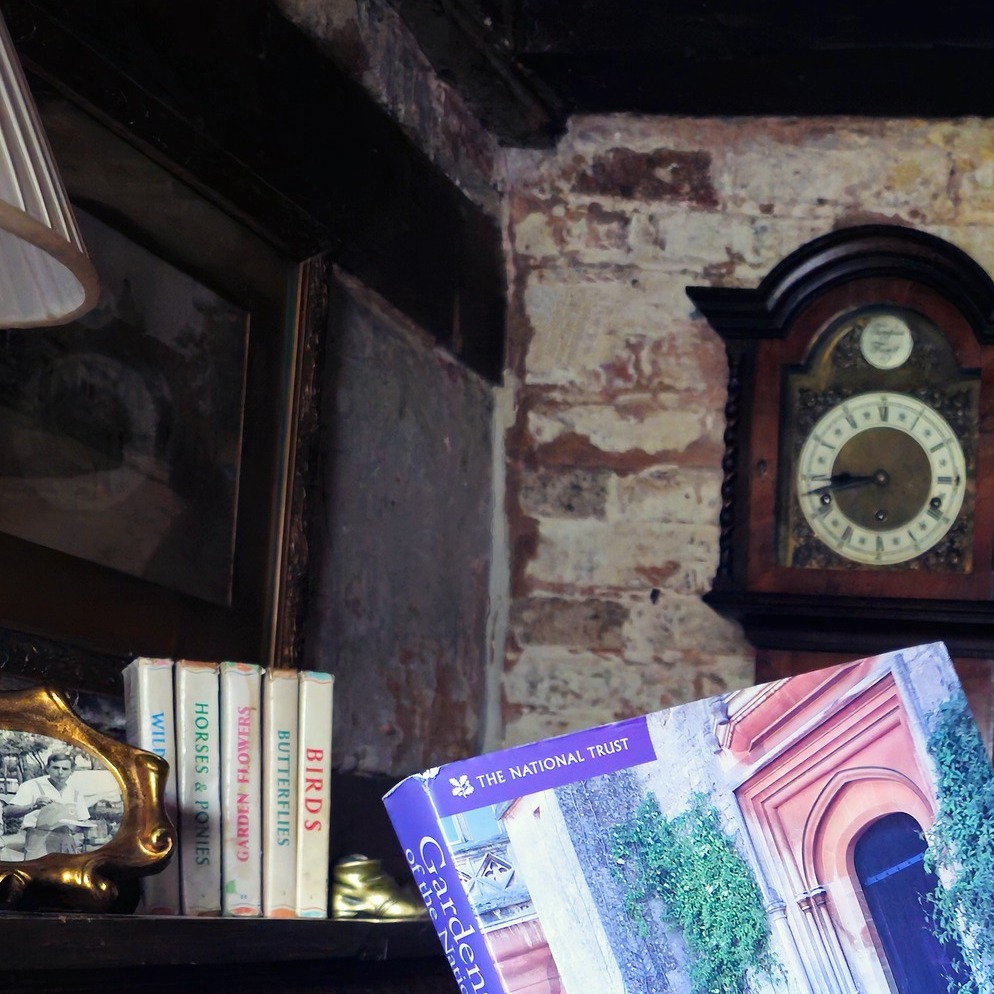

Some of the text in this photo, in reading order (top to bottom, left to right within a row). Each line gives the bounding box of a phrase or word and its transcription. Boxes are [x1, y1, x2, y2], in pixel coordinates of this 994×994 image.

[194, 702, 211, 867] HORSES & PONIES
[236, 705, 251, 863] GARDEN FLOWERS
[277, 729, 292, 847] BUTTERFLIES
[303, 747, 325, 833] BIRDS
[476, 738, 629, 788] THE NATIONAL TRUST
[405, 847, 425, 877] of
[418, 879, 439, 920] the
